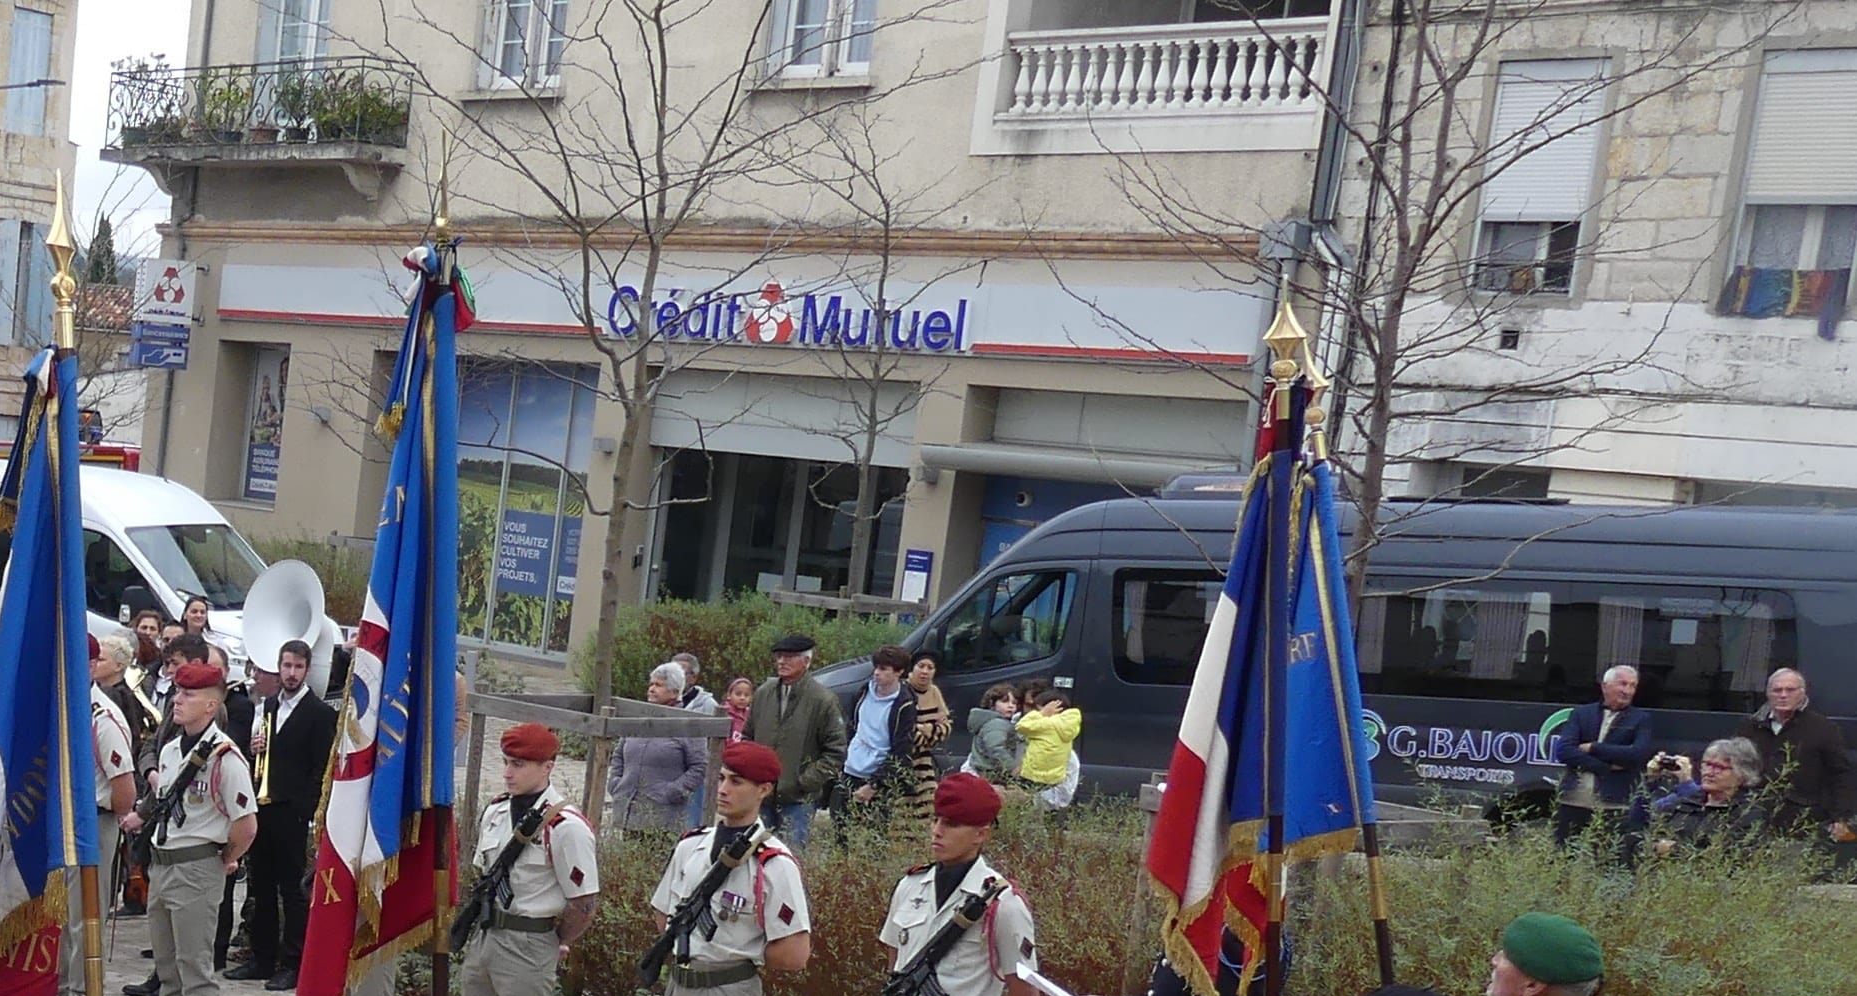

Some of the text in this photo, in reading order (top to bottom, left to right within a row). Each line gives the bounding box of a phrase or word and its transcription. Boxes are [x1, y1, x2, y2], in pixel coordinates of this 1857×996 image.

[607, 286, 967, 352] Crédit Mutuel
[504, 521, 527, 533] VOUS
[502, 533, 548, 549] SOUHAITEZ
[501, 545, 540, 560] CULTIVER
[499, 558, 517, 568] VOS
[1416, 764, 1515, 785] TRANSPORTS
